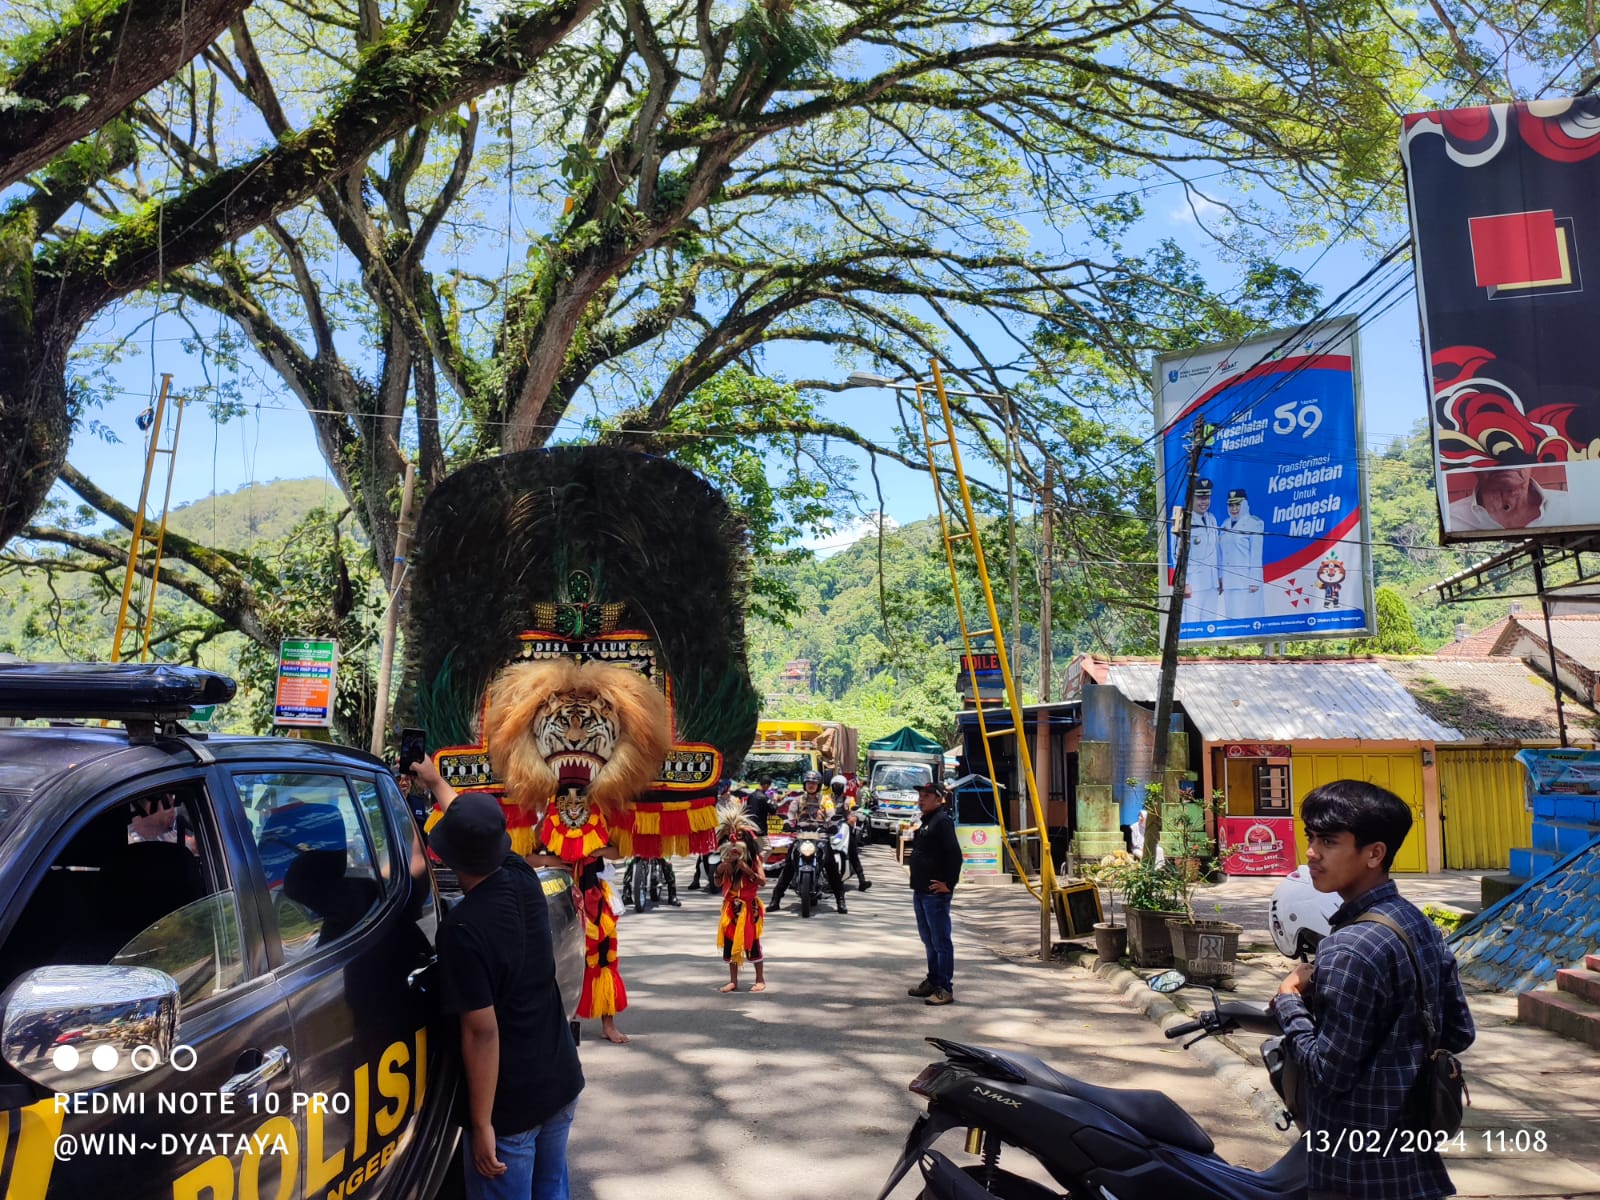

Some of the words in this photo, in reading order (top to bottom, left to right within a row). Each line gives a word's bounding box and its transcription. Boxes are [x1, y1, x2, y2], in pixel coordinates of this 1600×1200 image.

[1216, 418, 1268, 440] Kesehatan
[1273, 400, 1322, 438] 59
[1222, 430, 1264, 452] Nasional
[1277, 452, 1330, 474] Transformasi
[1268, 464, 1342, 494] Kesehatan
[1294, 487, 1317, 500] Untuk
[1272, 494, 1341, 523] Indonesia
[1289, 516, 1325, 538] Maju
[536, 643, 568, 652] DESA
[583, 643, 626, 652] TALUN
[961, 656, 998, 669] TOILE
[447, 764, 490, 776] PONO
[665, 761, 706, 772] ROGO
